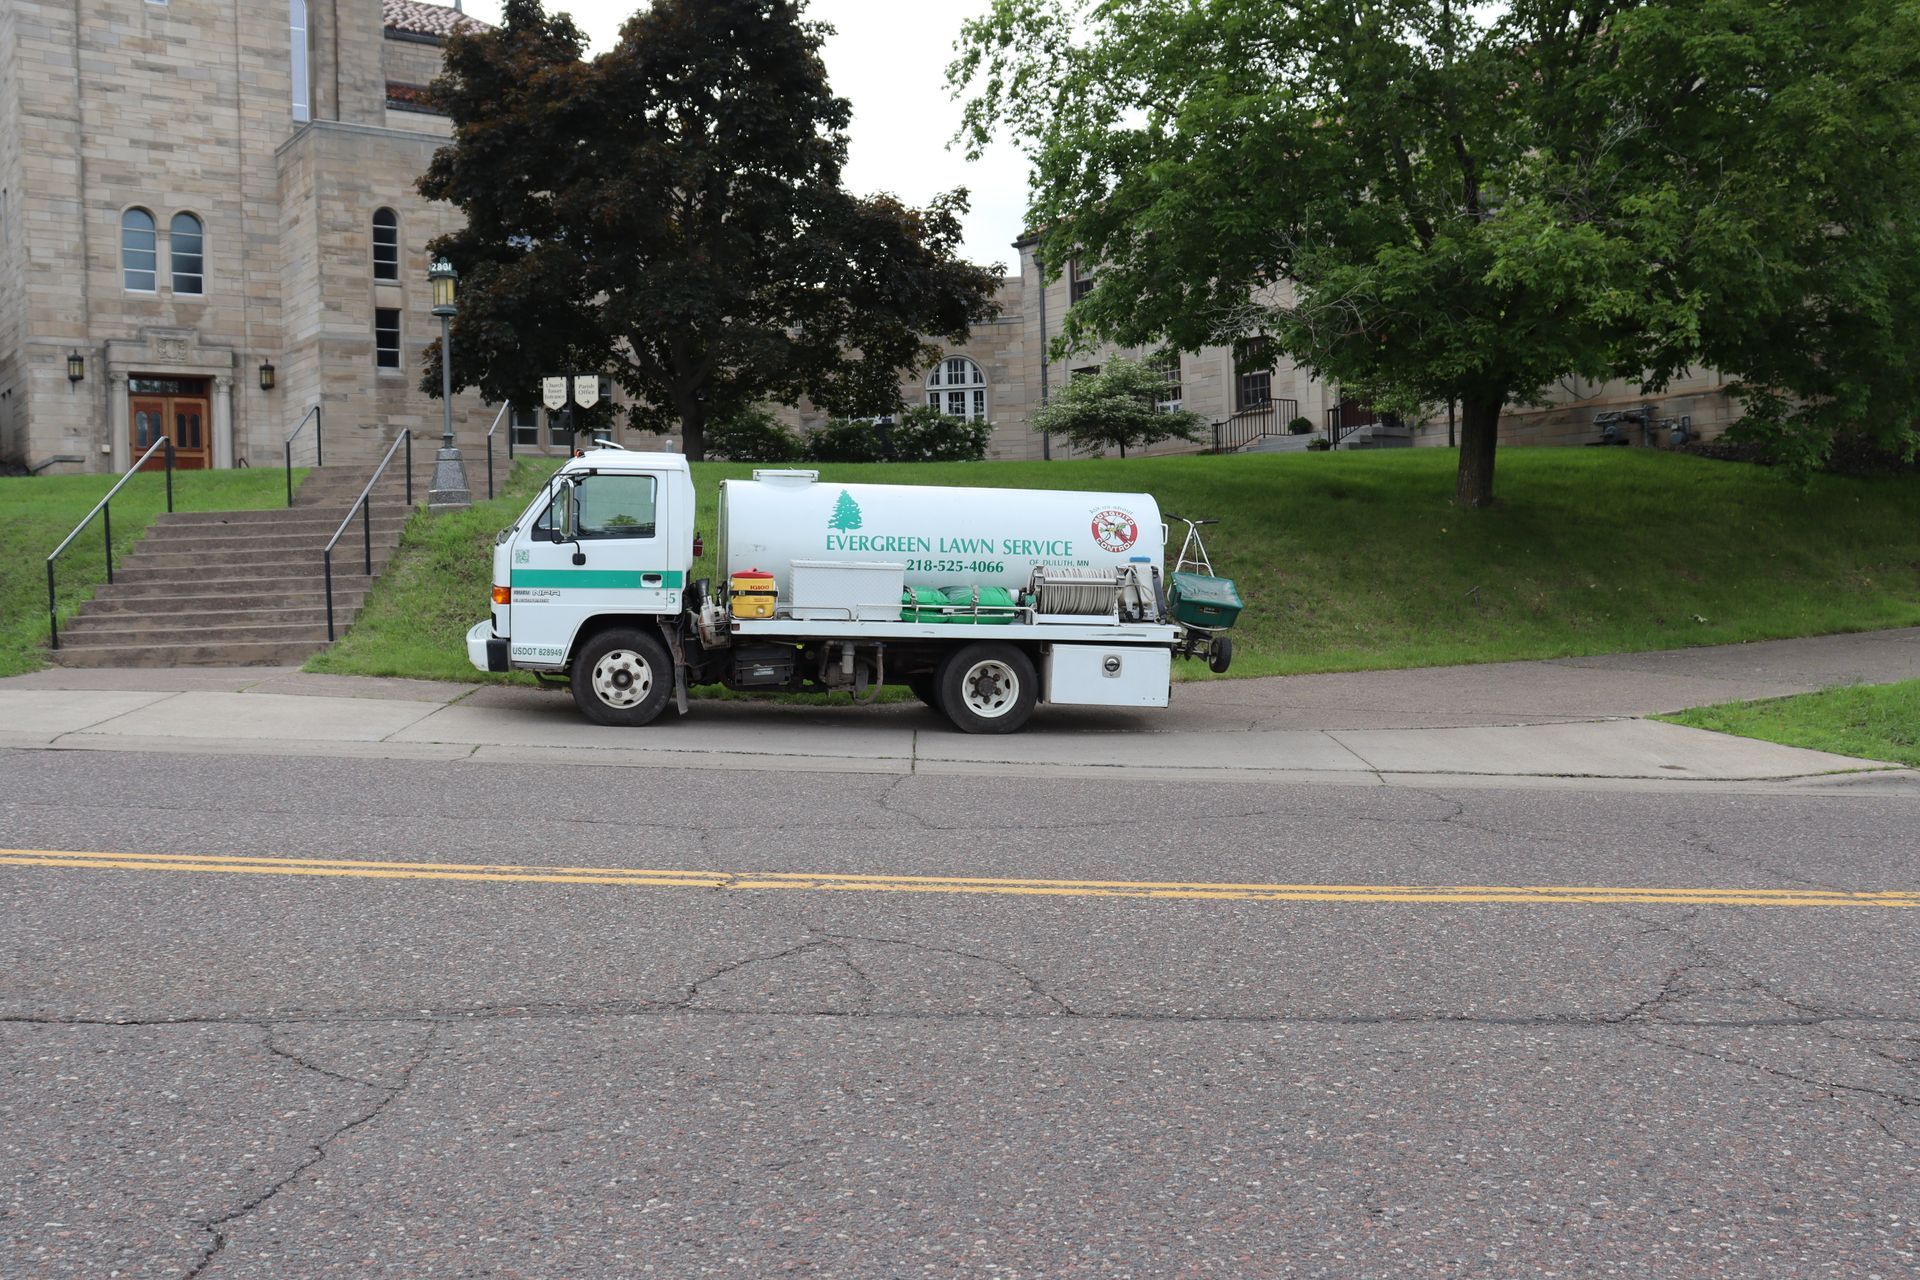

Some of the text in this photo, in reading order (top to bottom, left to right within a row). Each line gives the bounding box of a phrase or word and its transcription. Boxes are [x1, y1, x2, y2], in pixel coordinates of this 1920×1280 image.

[431, 262, 452, 271] 2801
[1094, 511, 1134, 526] MOSQUITO
[826, 535, 1072, 556] EVERGREEN LAWN SERVICE
[1096, 538, 1134, 552] CONTROL
[906, 559, 1004, 573] 218-525-4066
[668, 592, 676, 604] 5
[512, 648, 536, 656] USDOT
